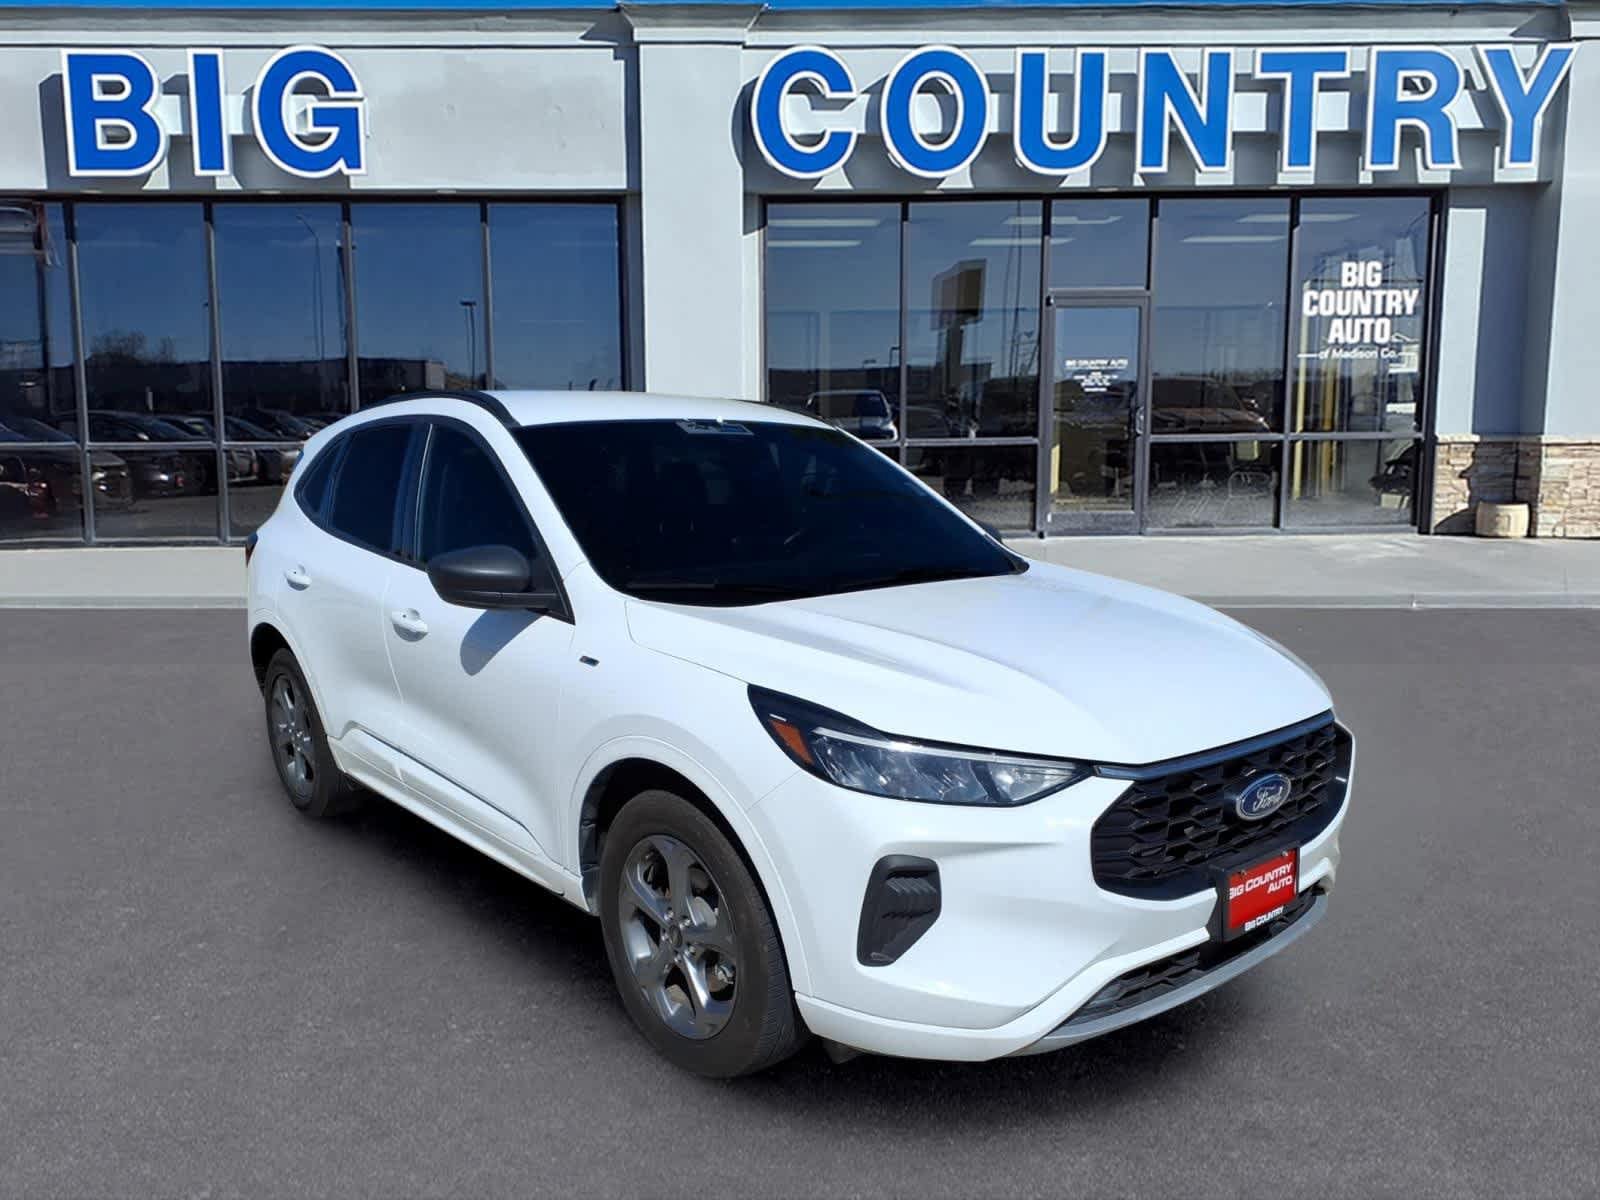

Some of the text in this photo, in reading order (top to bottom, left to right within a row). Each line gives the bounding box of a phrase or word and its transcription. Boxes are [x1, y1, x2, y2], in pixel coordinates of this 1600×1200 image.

[61, 44, 1576, 180] BIG COUNTRY
[1341, 261, 1382, 288] BIG
[1303, 289, 1419, 316] COUNTRY
[1328, 317, 1391, 344] AUTO
[1331, 348, 1378, 360] Madison
[1252, 786, 1284, 812] Ford
[1245, 862, 1293, 892] COUNTRY
[1267, 875, 1293, 894] AUTO
[1255, 906, 1284, 927] COUNTRY
